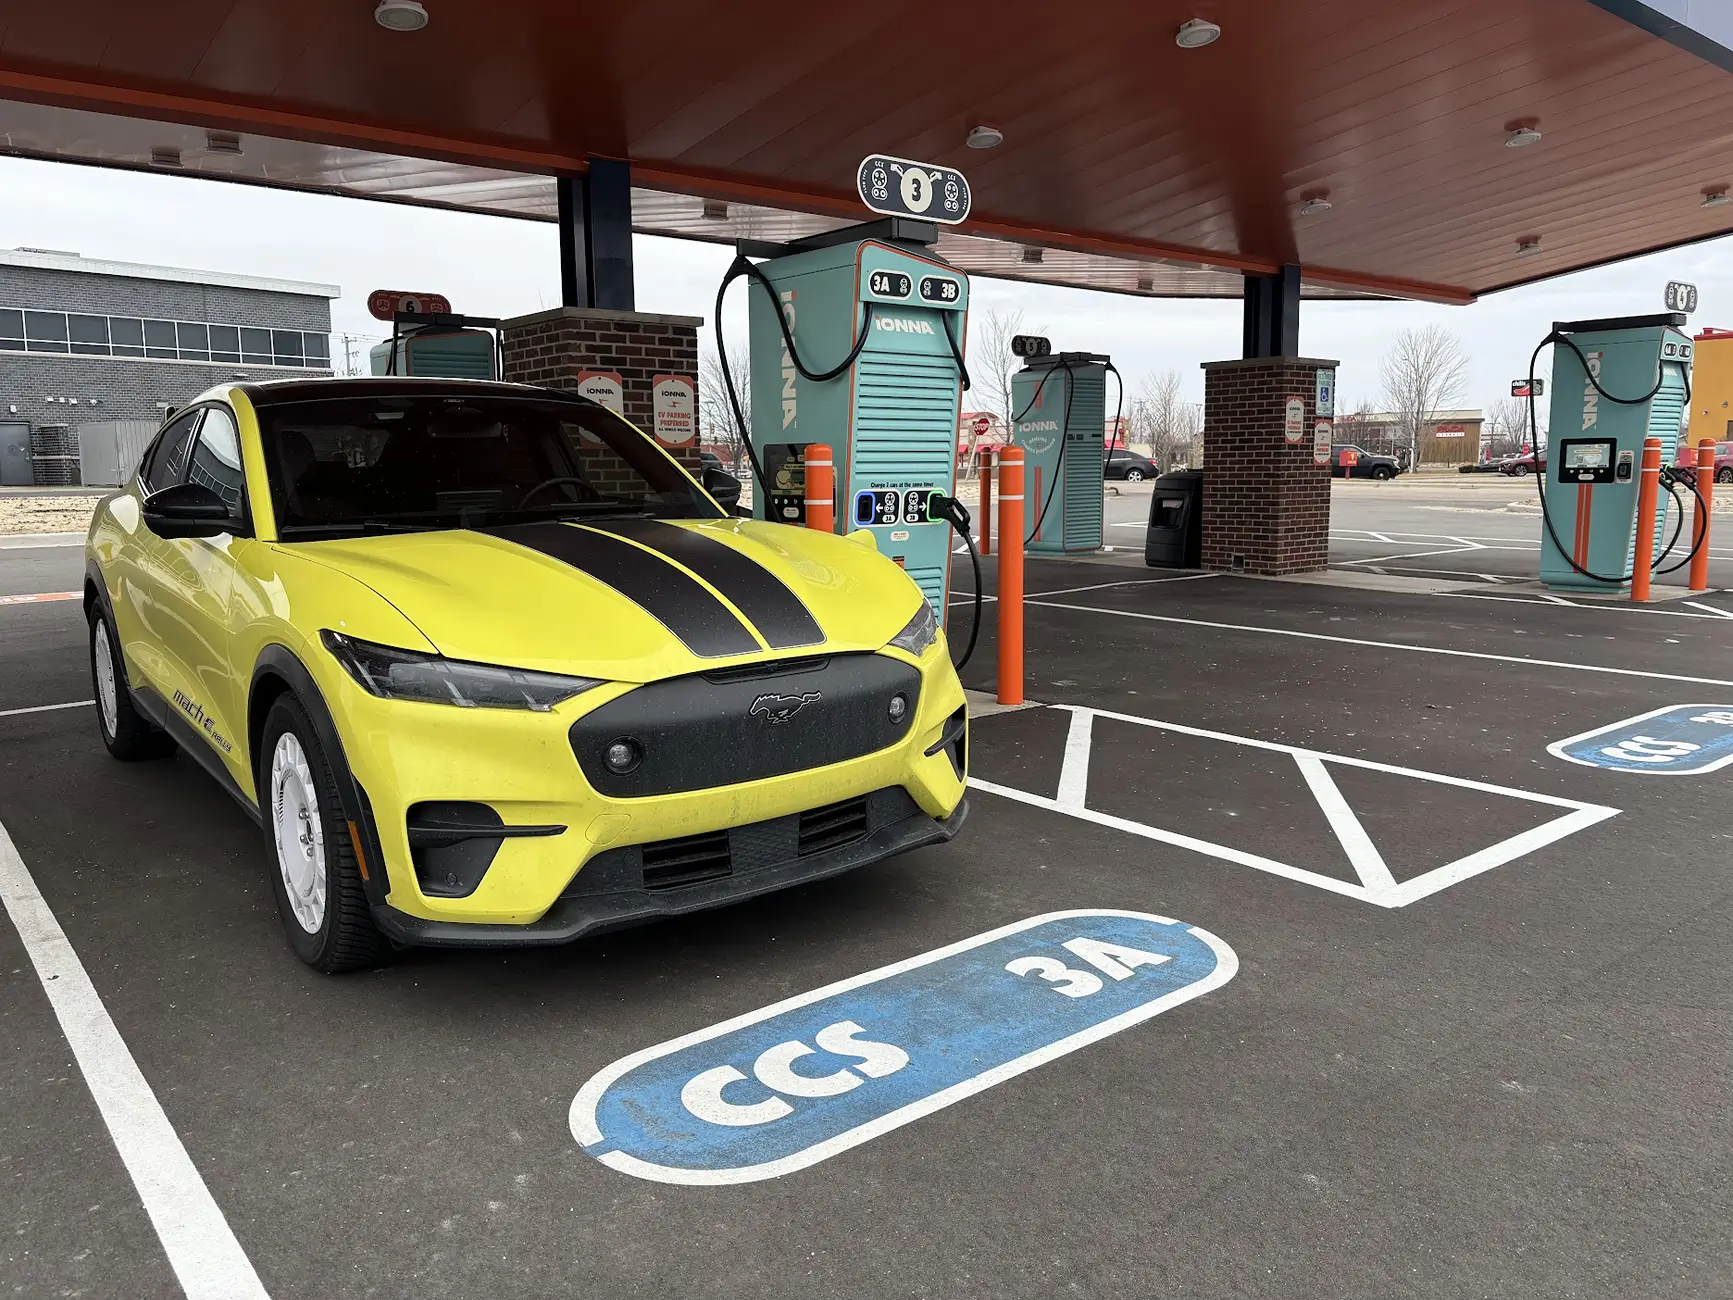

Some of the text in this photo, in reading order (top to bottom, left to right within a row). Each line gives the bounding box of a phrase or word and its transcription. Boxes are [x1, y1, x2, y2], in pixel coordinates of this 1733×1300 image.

[912, 178, 922, 202] 3
[873, 276, 890, 293] 3A
[942, 283, 956, 298] 3B
[975, 423, 989, 431] STOP
[1601, 736, 1702, 762] CCS
[1004, 936, 1172, 998] 3A
[680, 1020, 910, 1126] CCS
